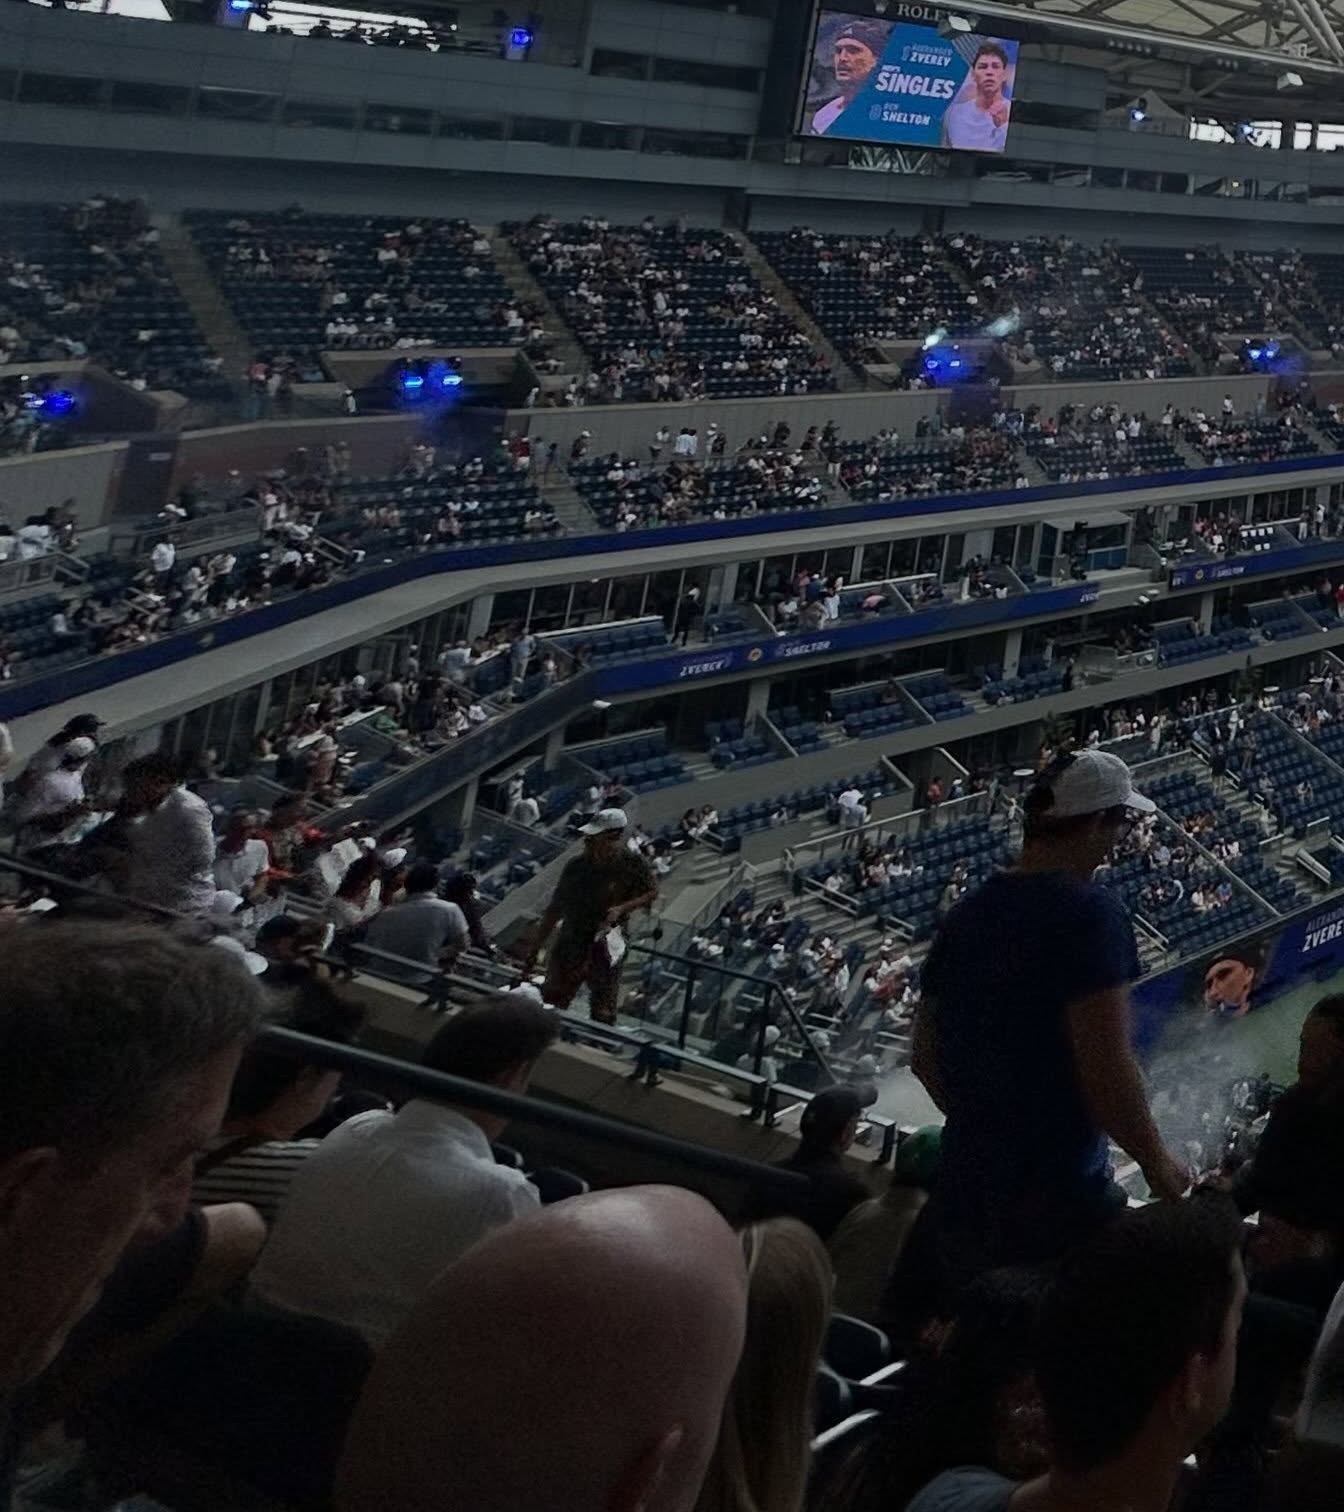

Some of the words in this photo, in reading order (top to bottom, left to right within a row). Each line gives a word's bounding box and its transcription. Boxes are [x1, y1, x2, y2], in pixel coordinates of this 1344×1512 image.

[909, 52, 953, 68] ZVEREV
[874, 71, 956, 100] SINGLES
[882, 111, 932, 126] SHELTON
